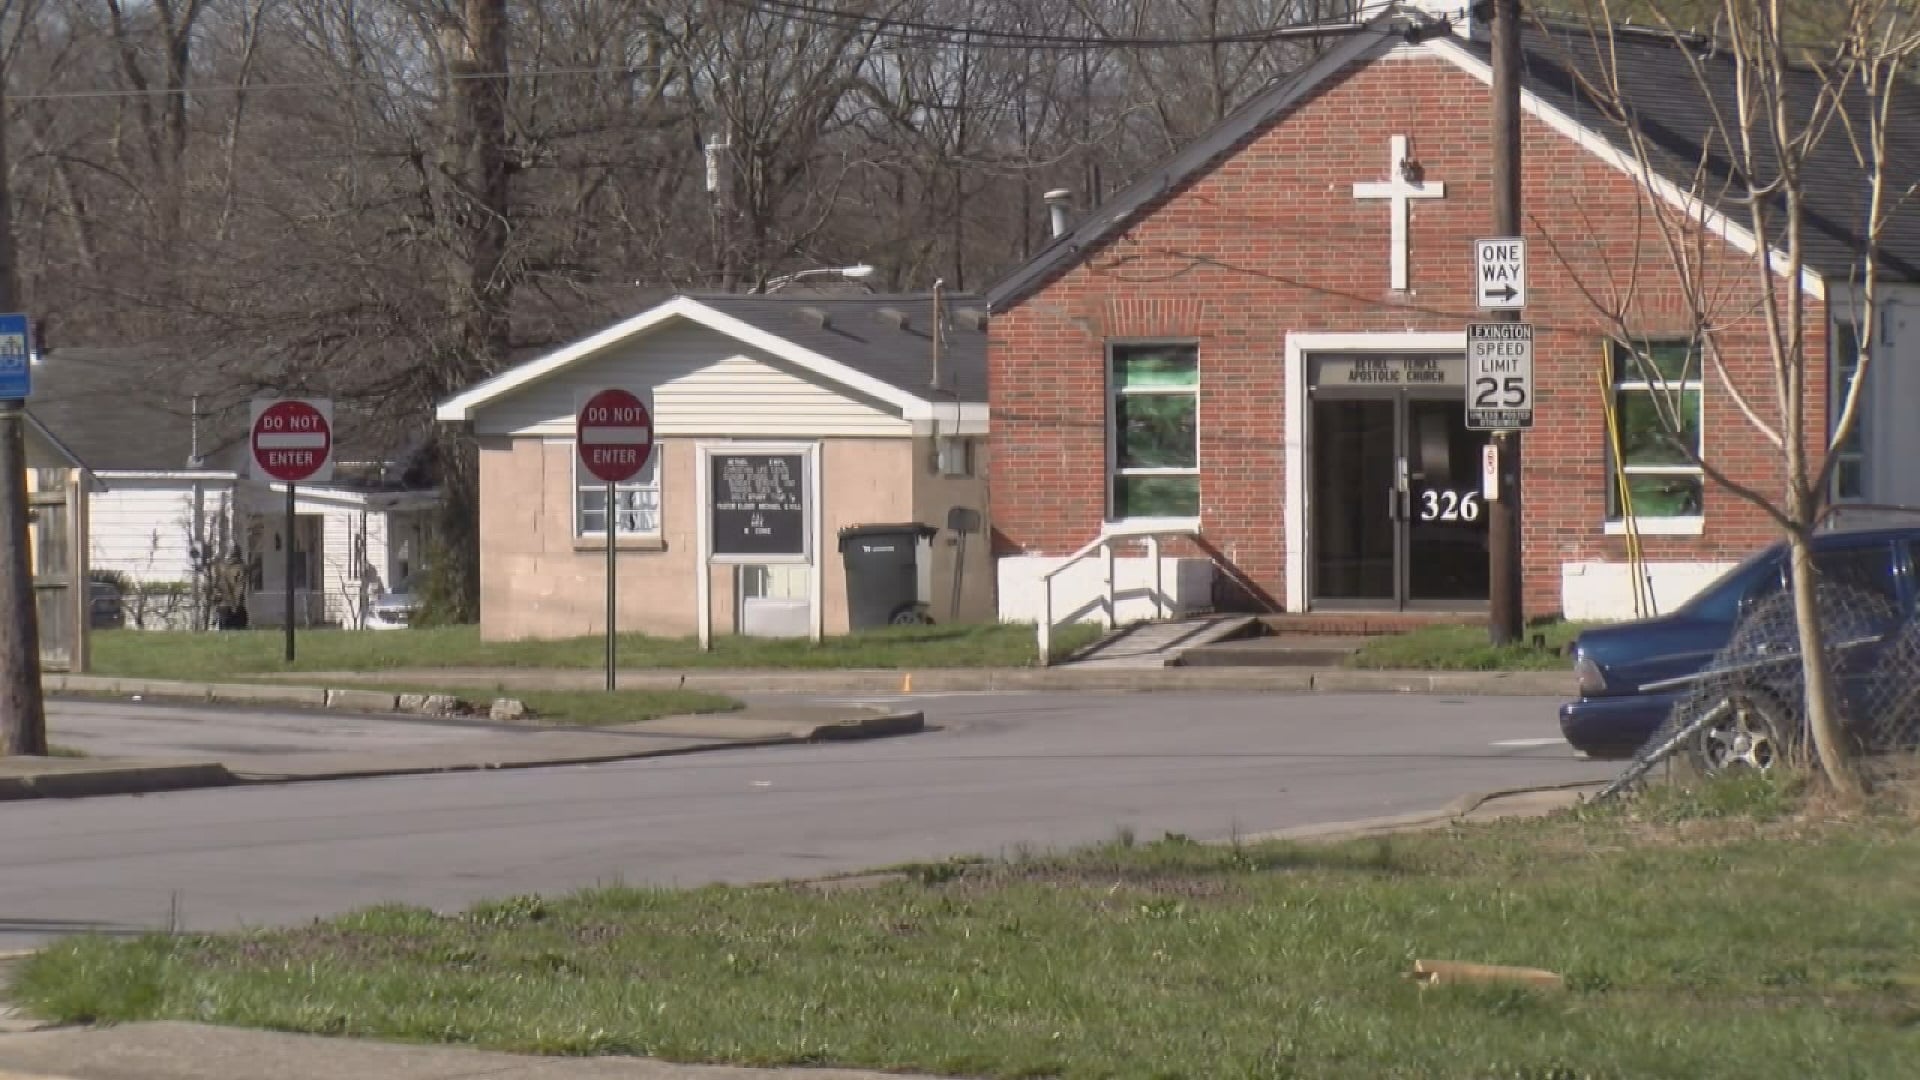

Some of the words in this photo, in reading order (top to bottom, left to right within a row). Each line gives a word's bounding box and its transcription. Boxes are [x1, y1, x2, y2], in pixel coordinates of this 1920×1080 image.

[1483, 245, 1519, 261] ONE
[1483, 264, 1520, 281] WAY
[1470, 324, 1530, 338] LEXINGTON
[1477, 342, 1524, 355] SPEED
[1481, 359, 1519, 372] LIMIT
[1348, 370, 1399, 383] APOSTOLIC
[1406, 370, 1445, 383] CHURCH
[1475, 377, 1526, 408] 25
[263, 415, 283, 430] DO
[290, 414, 319, 430] NOT
[588, 407, 607, 421] DO
[614, 407, 642, 421] NOT
[269, 450, 313, 467] ENTER
[593, 448, 637, 464] ENTER
[1421, 490, 1479, 520] 326
